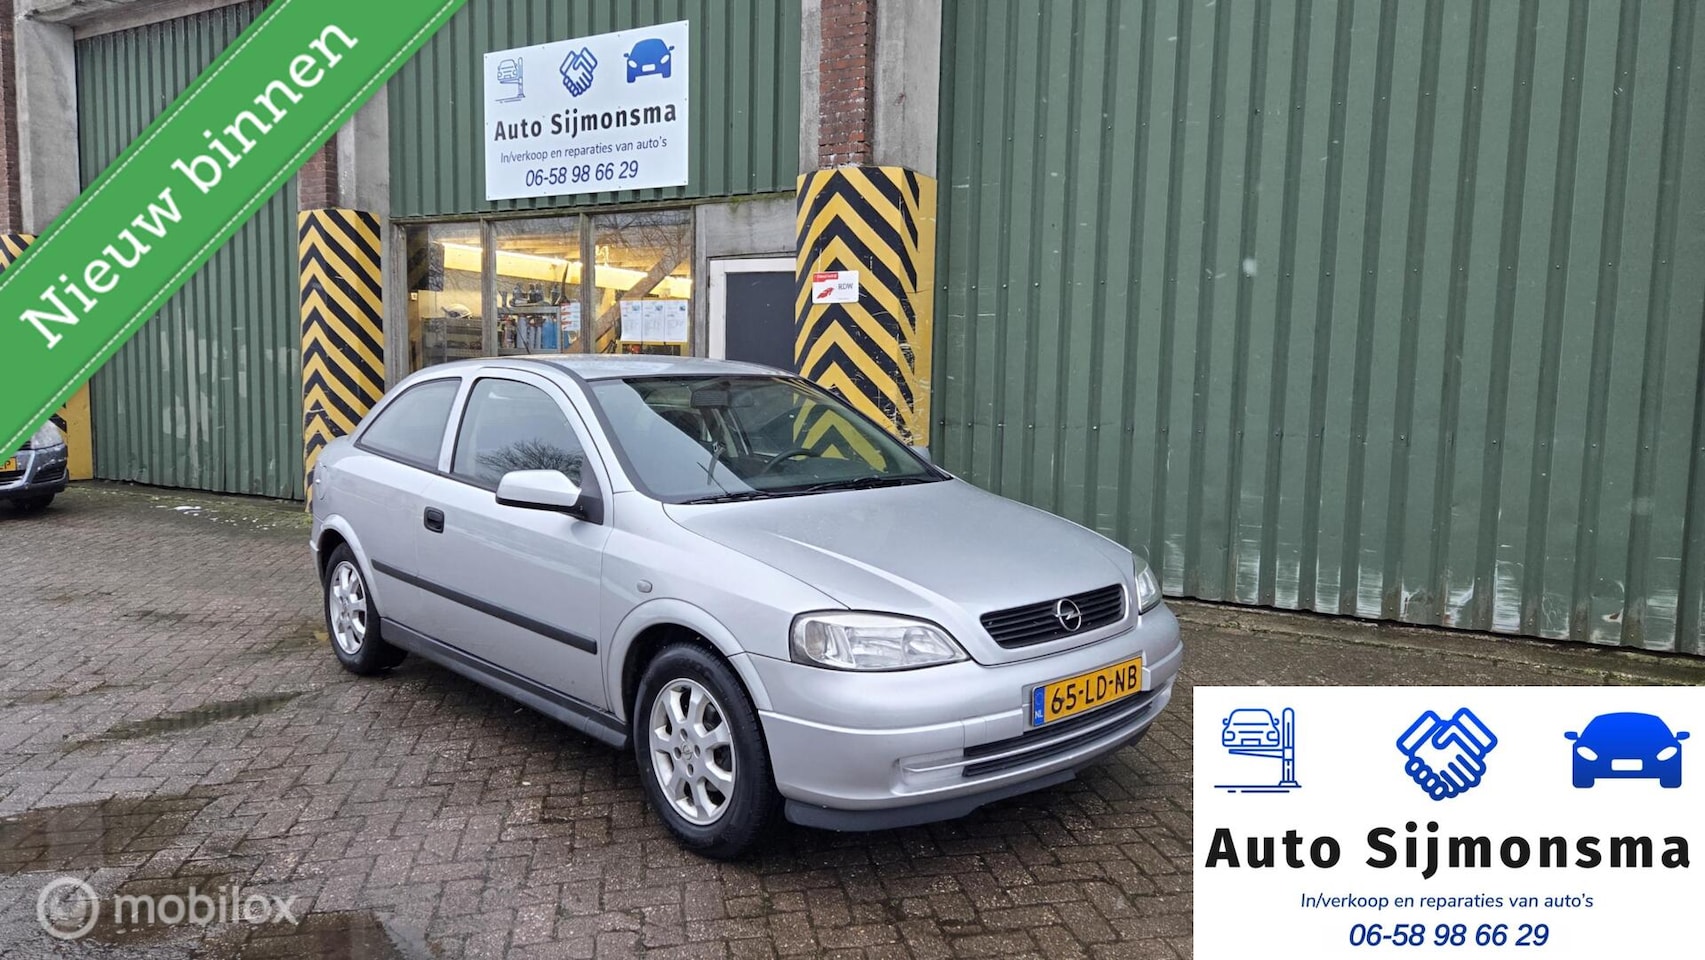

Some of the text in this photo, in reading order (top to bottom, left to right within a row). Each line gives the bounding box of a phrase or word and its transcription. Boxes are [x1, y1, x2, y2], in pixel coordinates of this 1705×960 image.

[494, 103, 677, 141] Auto Sijmonsma
[500, 135, 667, 164] In/verkoop en reparaties van auto's
[525, 160, 639, 187] 06-58 98 66 29
[1051, 665, 1137, 715] 65-LD-NB
[1034, 709, 1044, 720] NL
